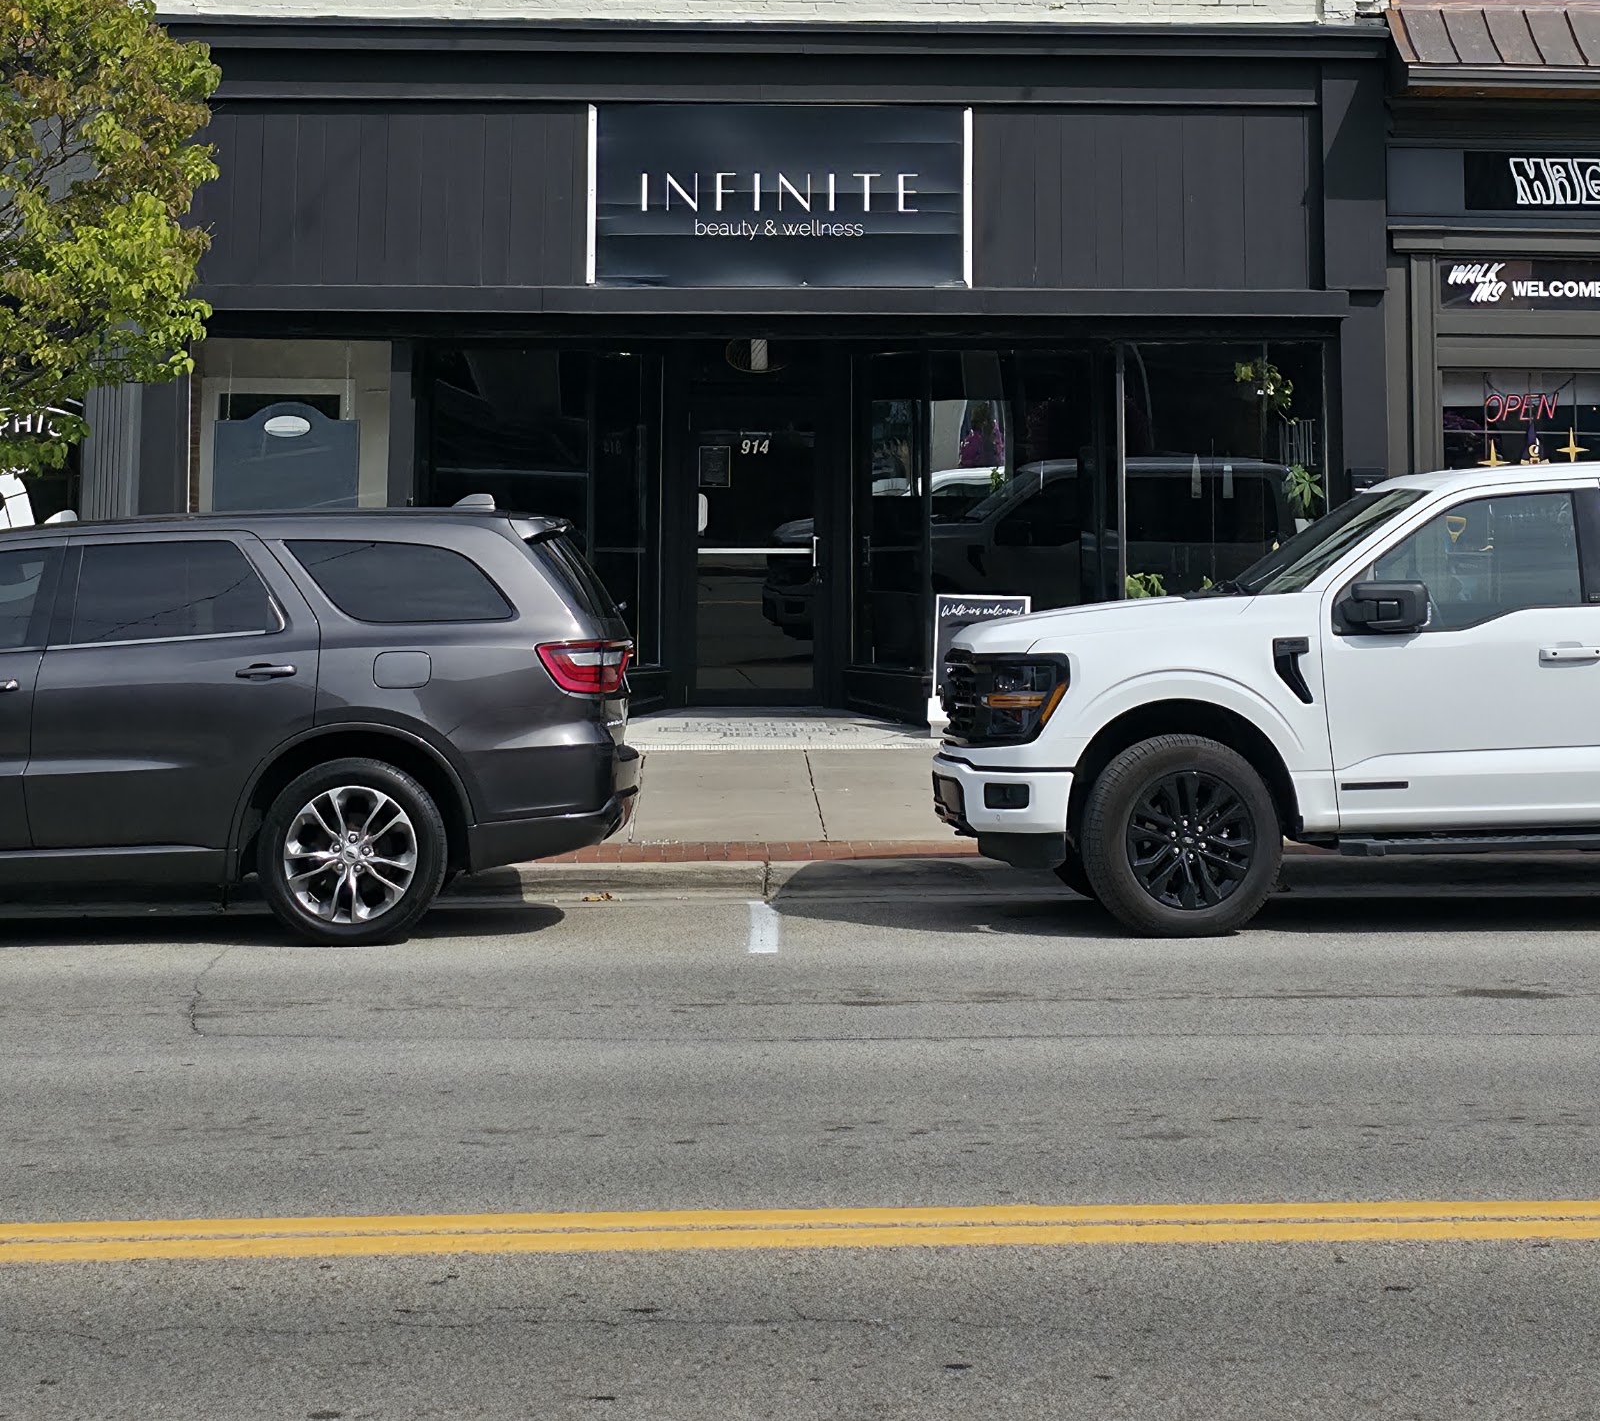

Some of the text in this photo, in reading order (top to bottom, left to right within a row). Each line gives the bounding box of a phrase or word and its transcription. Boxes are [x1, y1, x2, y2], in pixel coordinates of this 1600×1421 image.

[641, 172, 919, 213] INFINITE
[694, 219, 864, 241] beauty & wellness
[1447, 263, 1506, 284] WALK
[1469, 282, 1507, 302] INS
[1485, 393, 1559, 423] OPEN
[740, 439, 770, 455] 914
